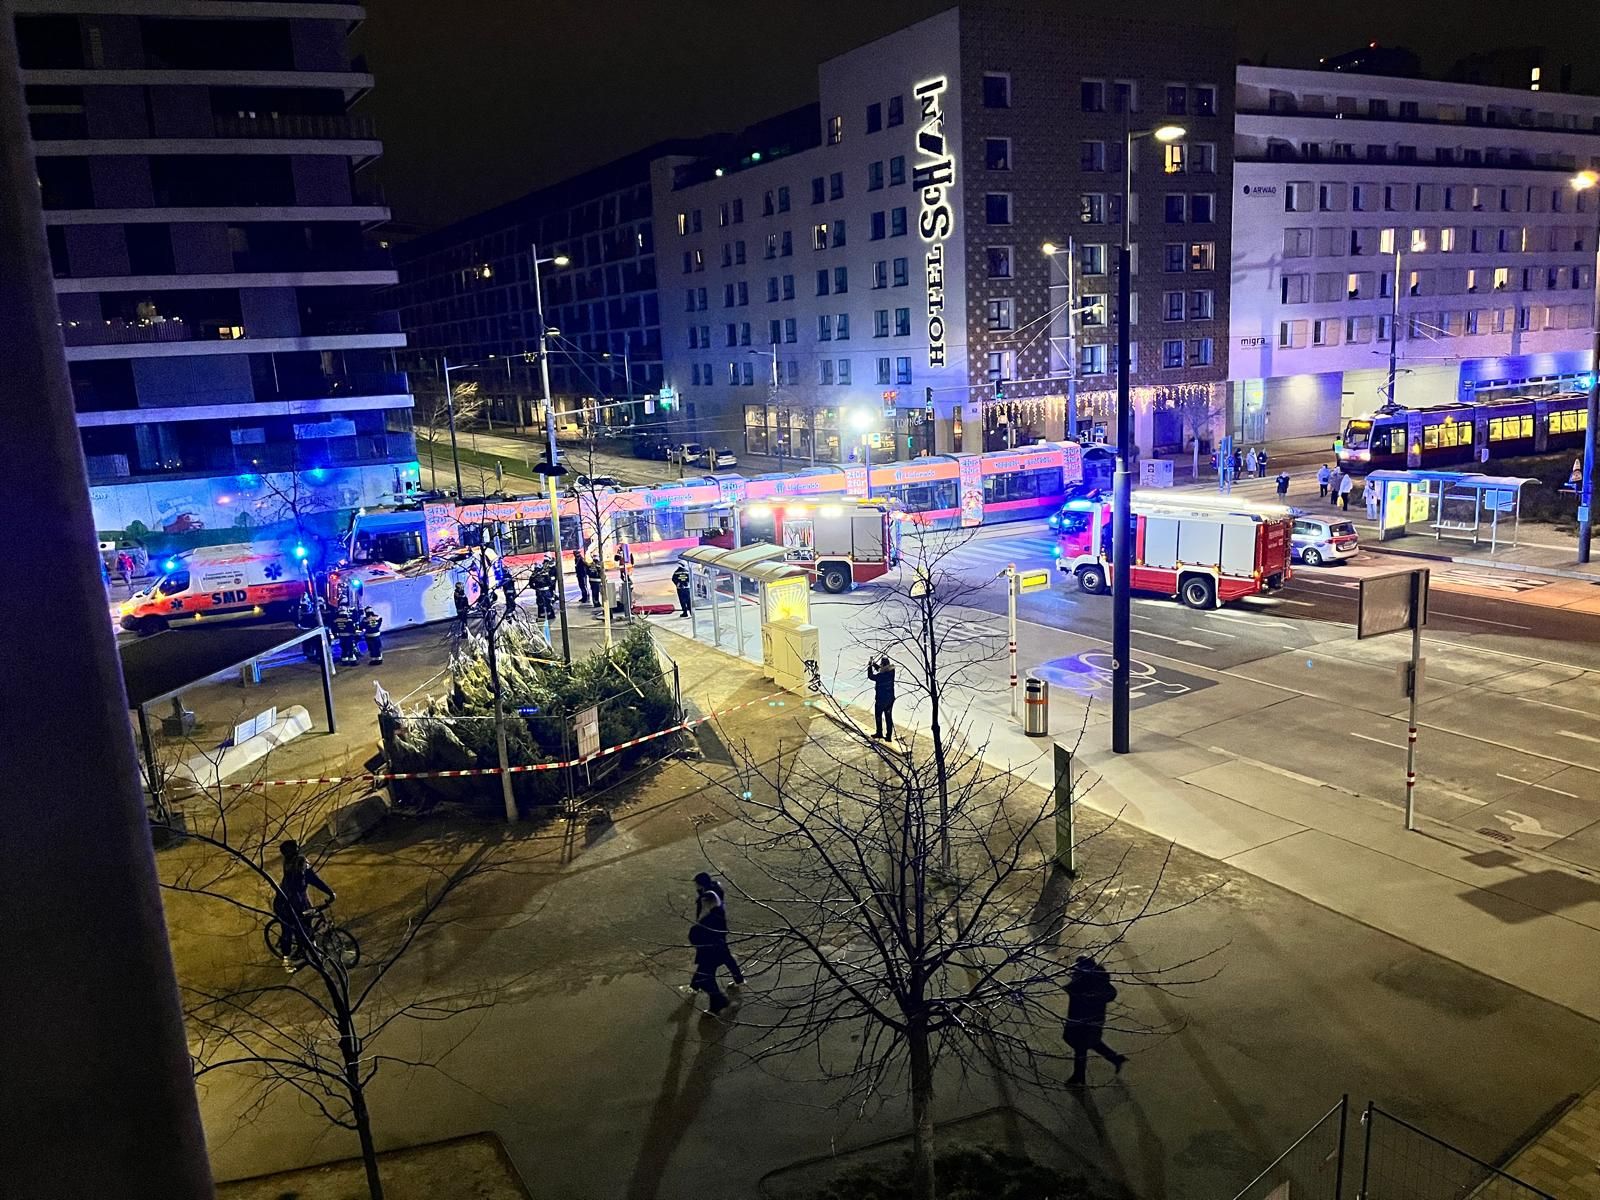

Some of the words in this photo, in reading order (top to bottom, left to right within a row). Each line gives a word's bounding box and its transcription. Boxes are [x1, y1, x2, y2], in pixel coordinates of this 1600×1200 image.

[926, 244, 945, 368] HOTEL
[1240, 337, 1266, 347] migra
[211, 589, 247, 605] SMD
